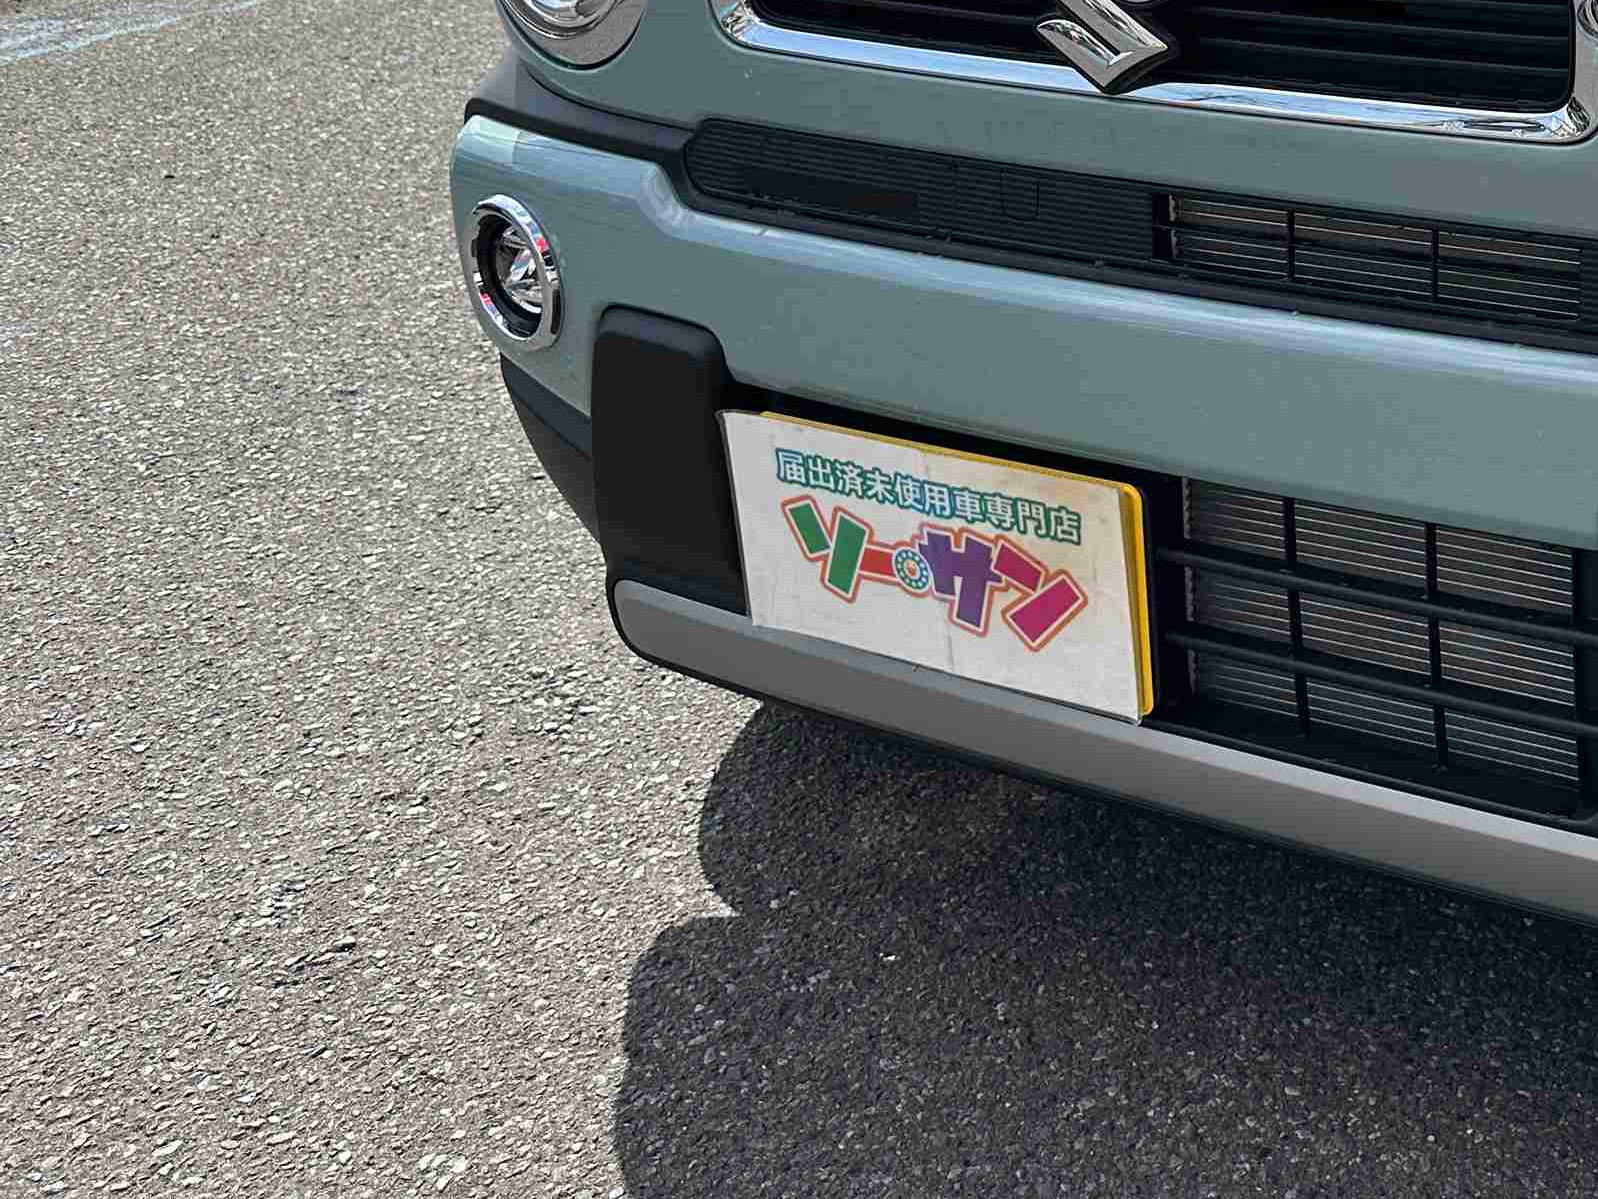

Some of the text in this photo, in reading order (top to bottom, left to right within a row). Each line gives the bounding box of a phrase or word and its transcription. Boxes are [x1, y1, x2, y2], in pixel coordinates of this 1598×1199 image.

[775, 448, 1082, 546] 届出済未使用車専門店
